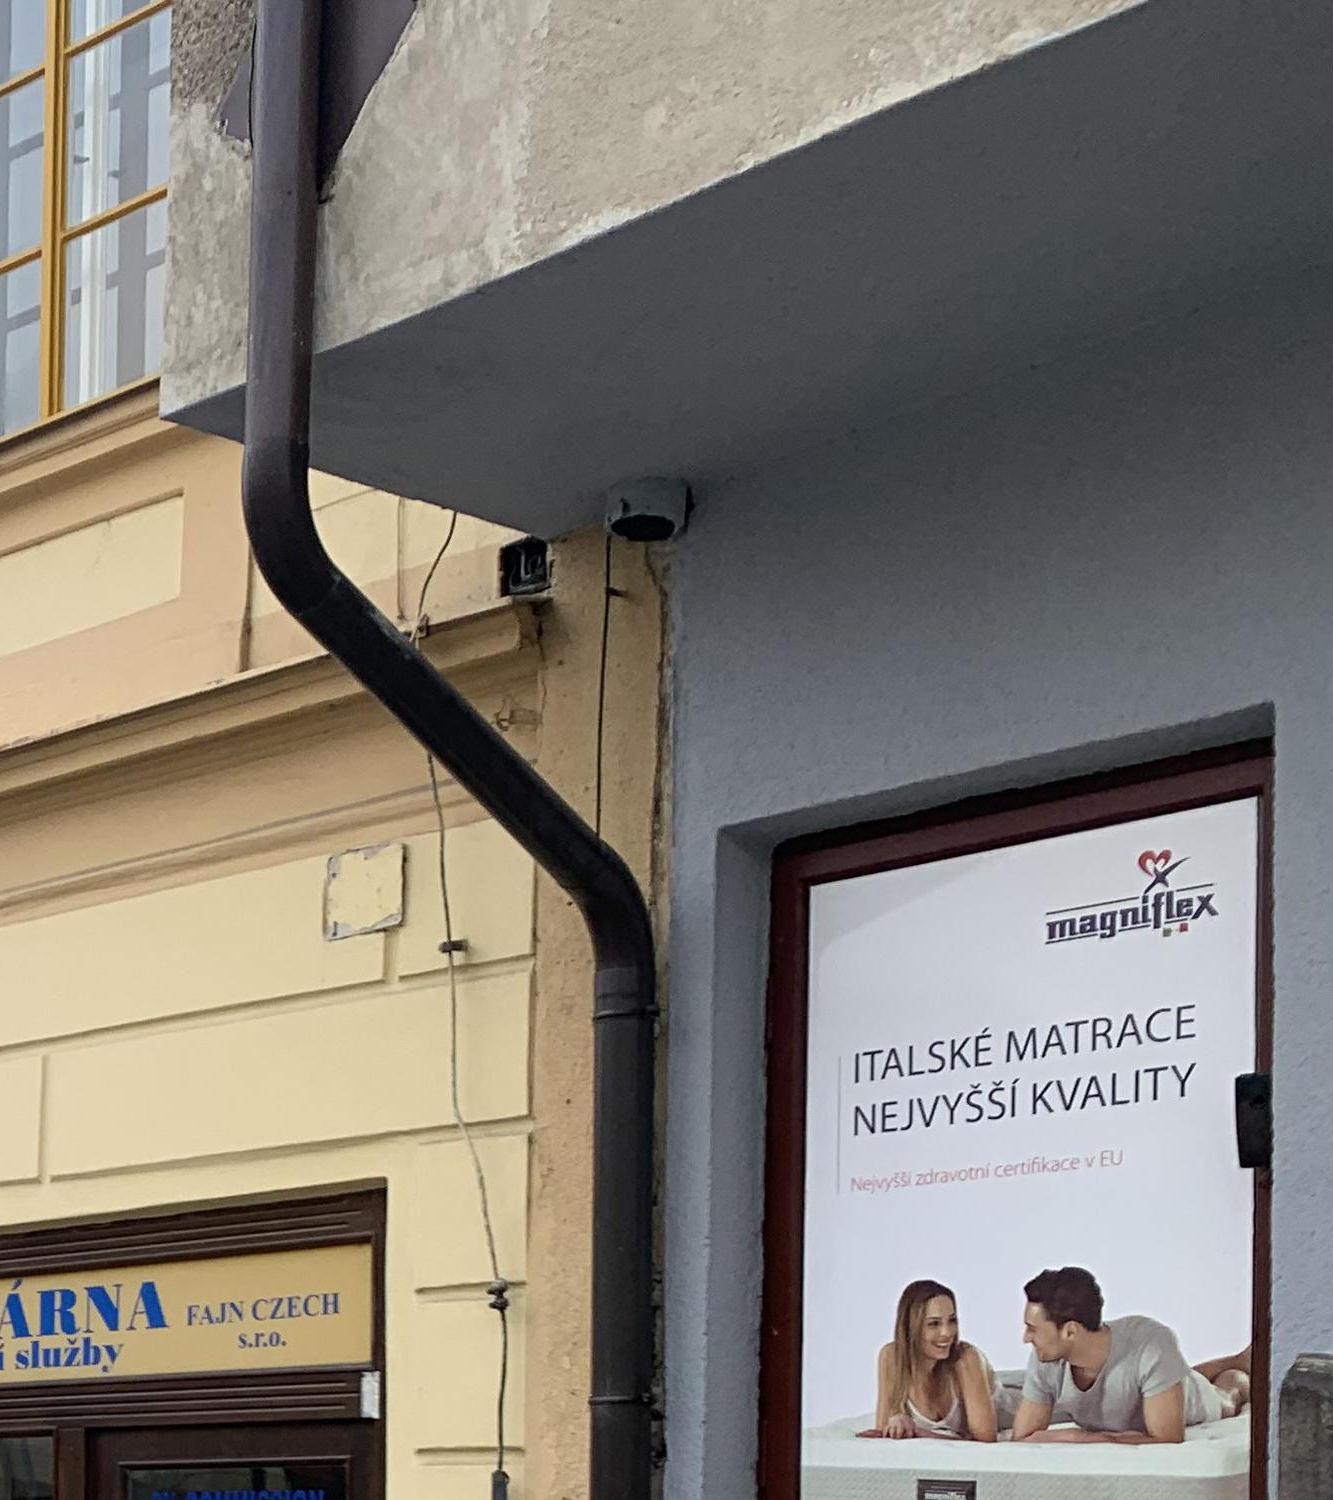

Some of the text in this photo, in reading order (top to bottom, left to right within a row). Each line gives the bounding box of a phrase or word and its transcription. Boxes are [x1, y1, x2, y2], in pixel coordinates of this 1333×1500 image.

[1045, 890, 1219, 939] magniflex
[852, 1004, 1197, 1084] ITALSKÉ MATRACE
[852, 1062, 1197, 1136] NEJVYŠŠÍ KVALITY
[850, 1149, 1124, 1193] Nejvyšší zdravotní certifikace v EU
[187, 1301, 244, 1326] FAJN
[251, 1292, 341, 1321] CZECH
[14, 1337, 124, 1373] služby
[238, 1331, 287, 1349] s.r.o.
